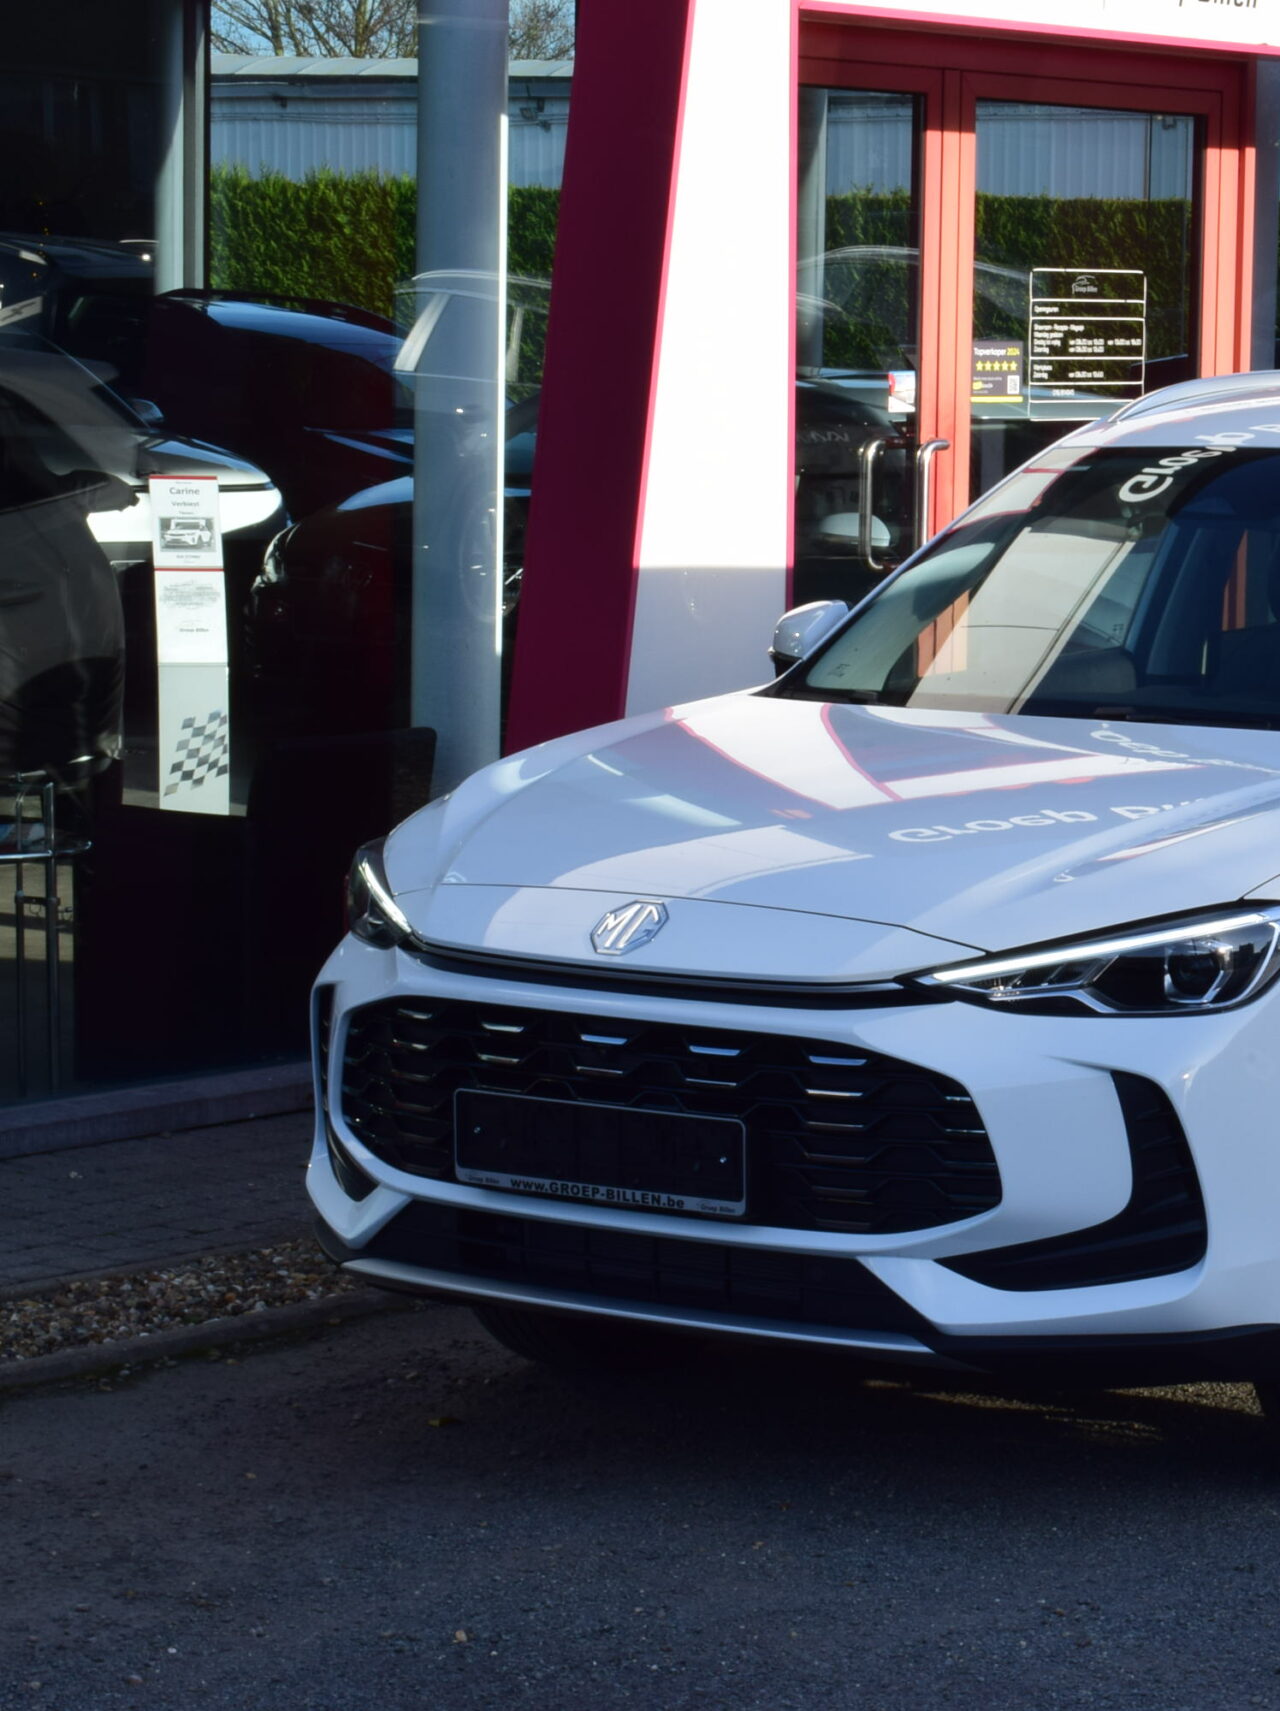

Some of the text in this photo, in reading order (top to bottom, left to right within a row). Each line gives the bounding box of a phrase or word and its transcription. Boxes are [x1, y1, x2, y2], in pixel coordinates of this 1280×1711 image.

[169, 486, 201, 496] Carine
[595, 902, 663, 952] MG
[510, 1178, 685, 1209] www.GROEP-BILLEN.be
